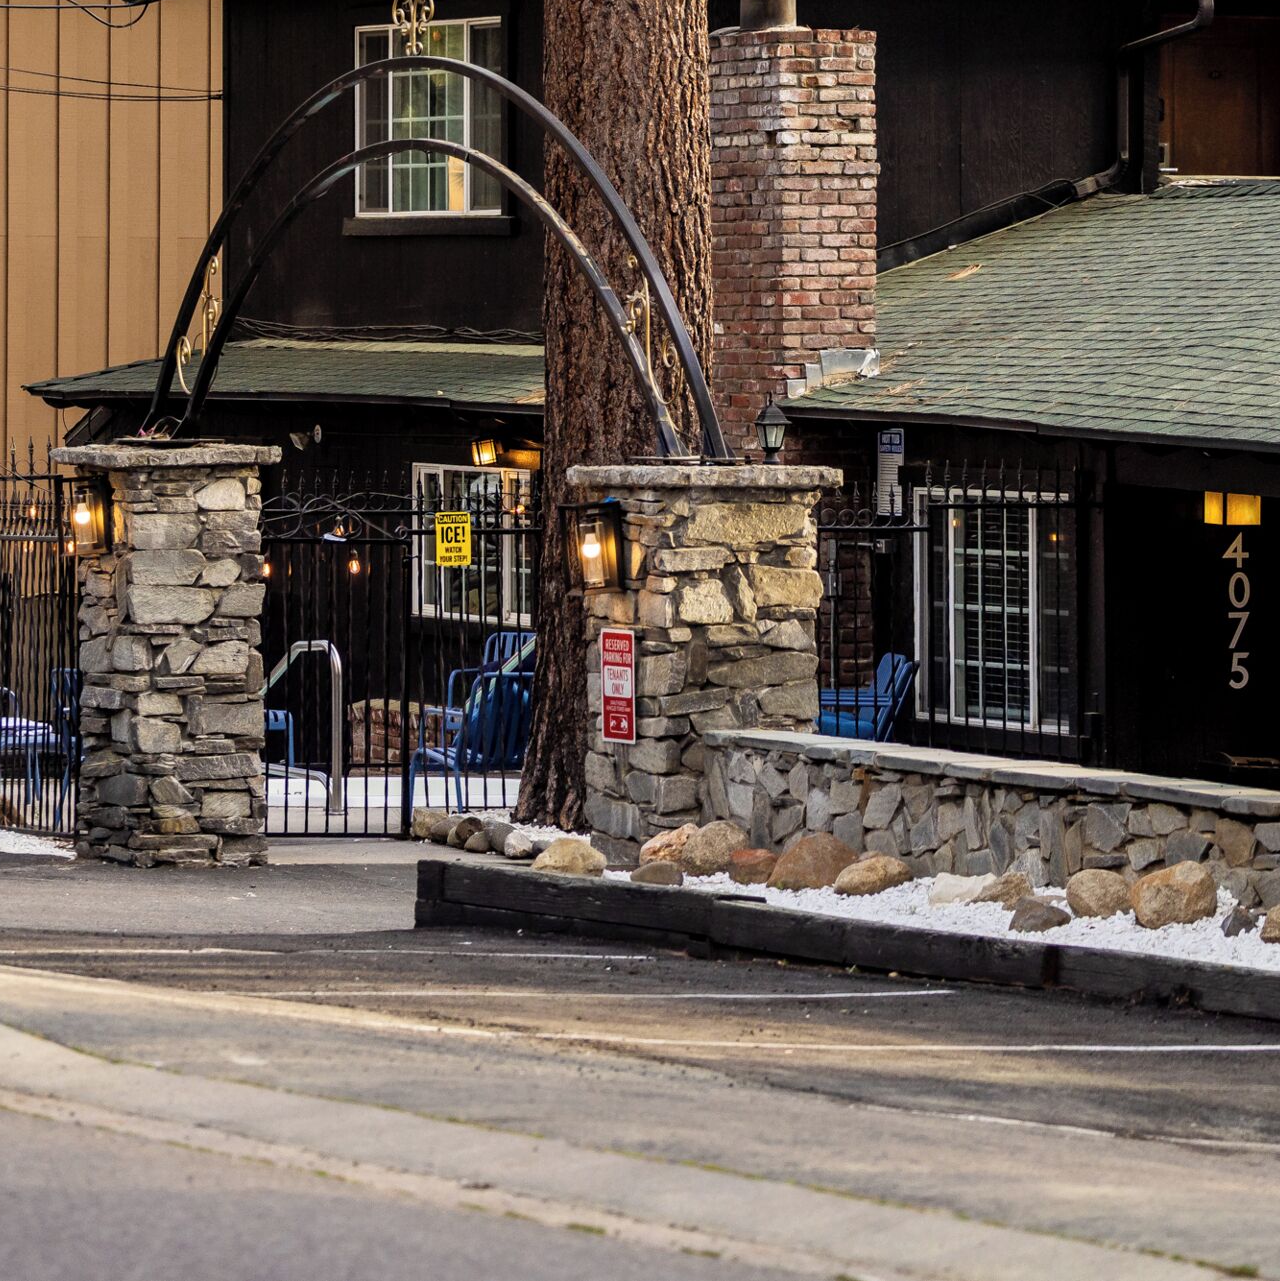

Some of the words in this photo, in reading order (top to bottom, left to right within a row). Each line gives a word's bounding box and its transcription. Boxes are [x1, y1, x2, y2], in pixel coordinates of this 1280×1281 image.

[438, 515, 468, 524] CAUTION
[441, 526, 466, 544] ICE!
[439, 555, 453, 563] YOUR
[1222, 531, 1251, 690] 4075
[605, 638, 630, 652] RESERVED
[603, 651, 622, 664] PARKING
[622, 652, 632, 665] FOR
[607, 668, 629, 682] TENANTS
[611, 682, 624, 695] ONLY
